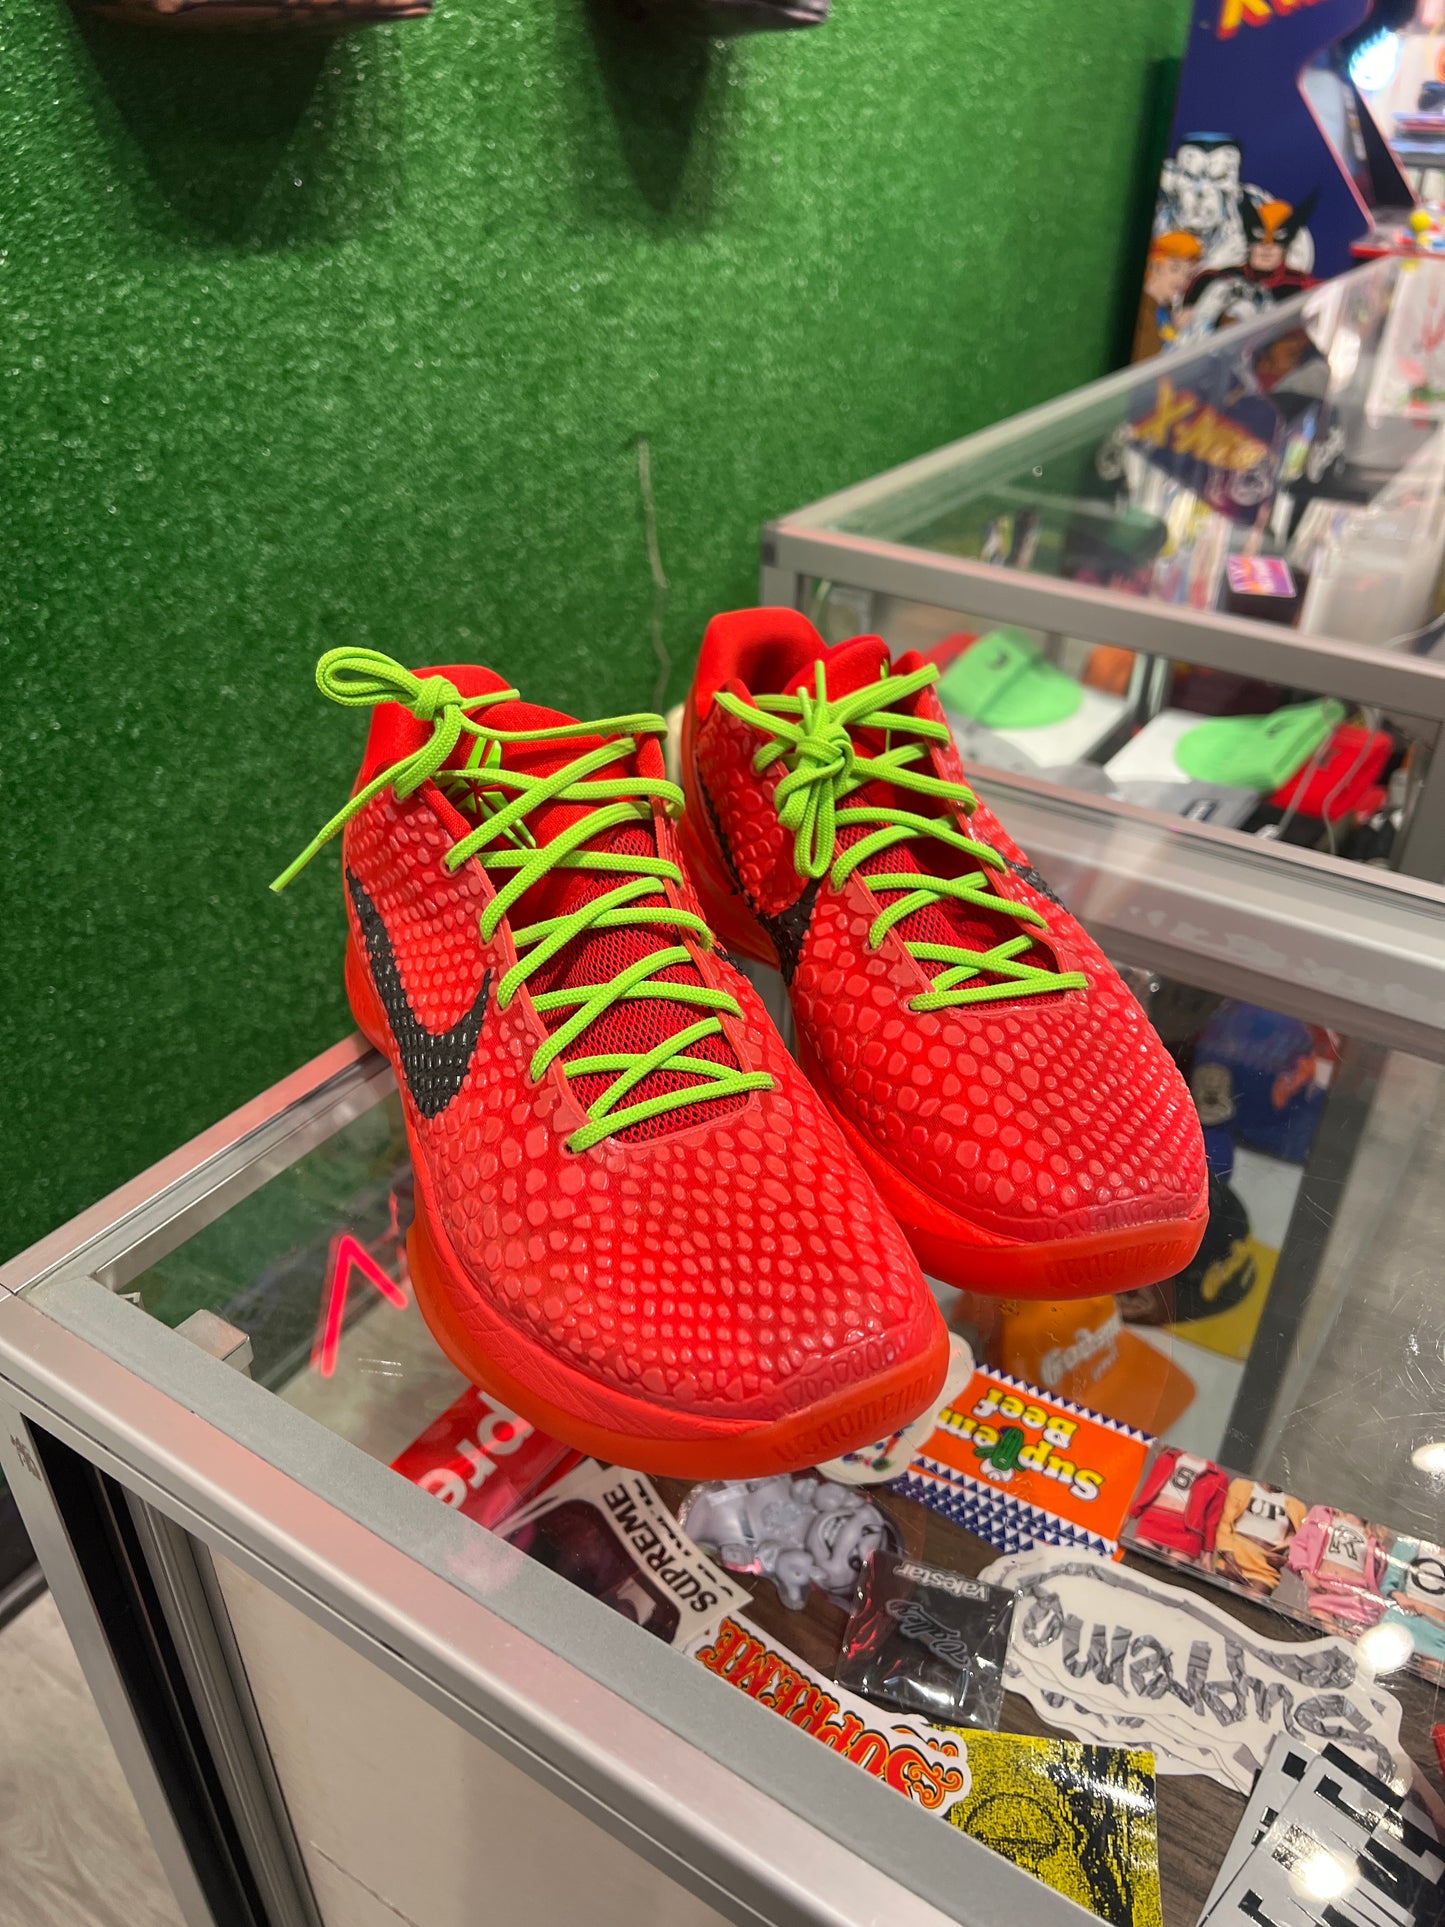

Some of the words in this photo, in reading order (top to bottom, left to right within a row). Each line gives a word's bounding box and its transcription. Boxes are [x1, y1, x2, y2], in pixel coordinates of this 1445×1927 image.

[936, 1406, 1105, 1501] Supem
[972, 1387, 1079, 1450] Beef
[602, 1483, 718, 1612] SUPREME
[1247, 1497, 1286, 1520] UP
[696, 1616, 963, 1809] SUPREME
[1020, 1566, 1398, 1788] Supreme
